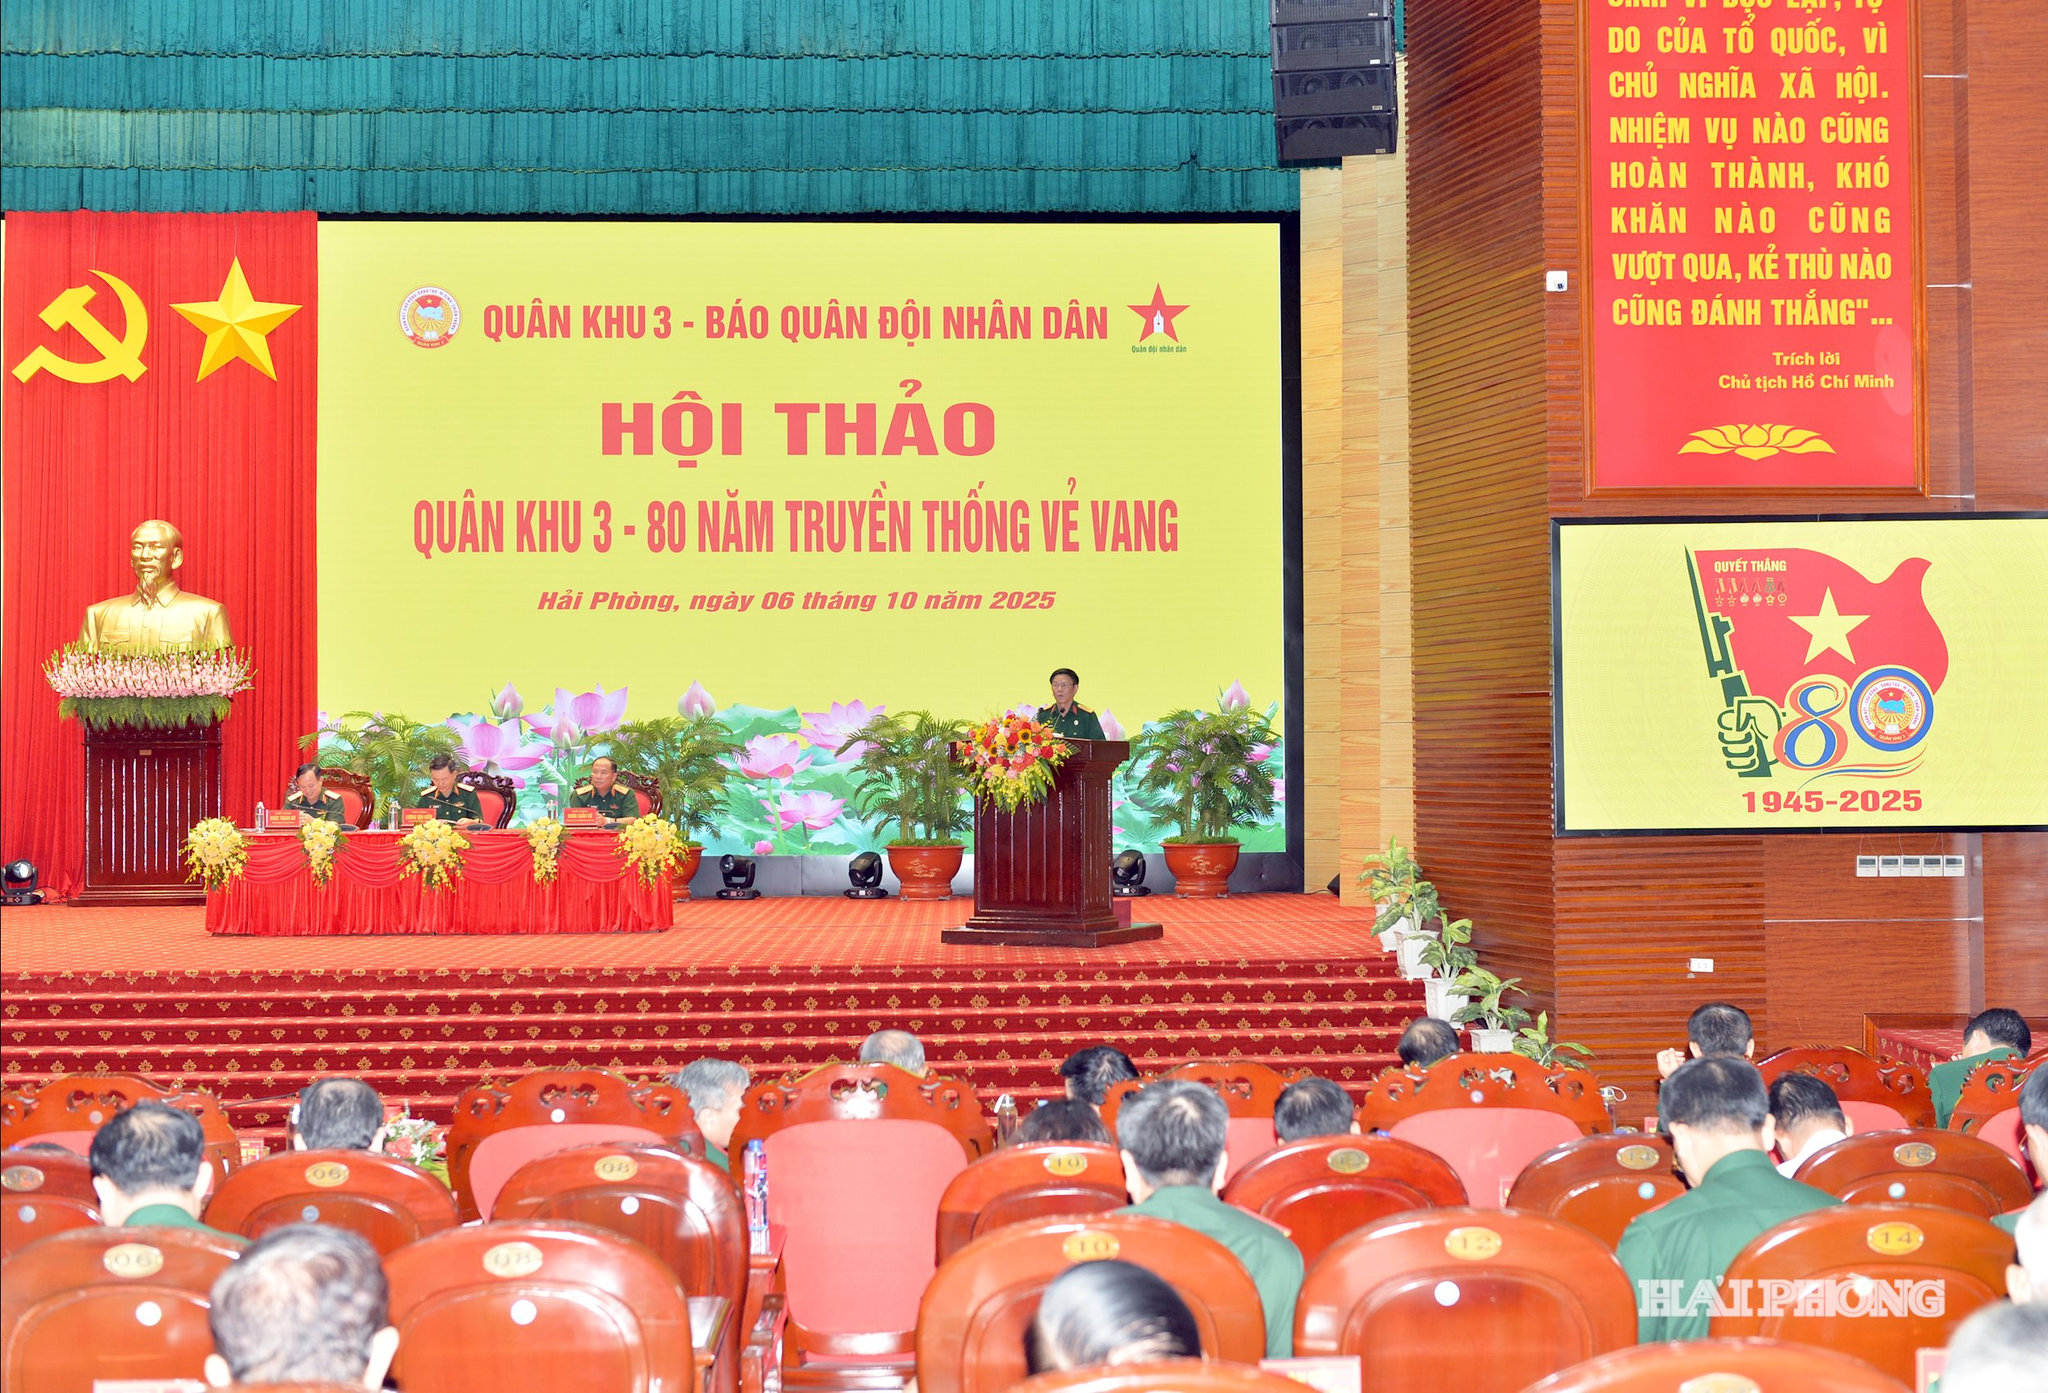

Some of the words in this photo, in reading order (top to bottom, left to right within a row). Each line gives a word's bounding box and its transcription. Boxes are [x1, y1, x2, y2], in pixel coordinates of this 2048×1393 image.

[1609, 26, 1640, 53] DO
[1658, 16, 1706, 53] CỦA
[1723, 13, 1755, 53] TỔ
[1771, 18, 1845, 56] QUỐC,
[1863, 22, 1887, 53] VÌ
[1609, 61, 1657, 98] CHỦ
[1680, 66, 1756, 98] NGHĨA
[1780, 67, 1815, 98] XÃ
[1837, 65, 1888, 104] HỘI.
[1610, 112, 1689, 149] NHIỆM
[1705, 118, 1737, 149] VỤ
[1753, 112, 1805, 143] NÀO
[1821, 112, 1888, 143] CŨNG
[1611, 156, 1686, 188] HOÀN
[1711, 156, 1814, 192] THÀNH,
[1837, 156, 1889, 188] KHÓ
[1612, 202, 1686, 233] KHĂN
[1715, 202, 1775, 233] NÀO
[1809, 202, 1890, 233] CŨNG
[1612, 251, 1676, 285] VƯỢT
[1683, 253, 1741, 283] QUA,
[1749, 244, 1779, 279] KẺ
[1785, 247, 1832, 279] THÙ
[1841, 247, 1891, 279] NÀO
[1613, 294, 1681, 325] CŨNG
[1691, 294, 1761, 325] ĐÁNH
[484, 298, 570, 342] QUÂN
[583, 306, 645, 339] KHU
[654, 306, 671, 338] 3
[706, 299, 768, 339] BÁO
[781, 299, 867, 343] QUÂN
[878, 299, 930, 347] ĐỘI
[944, 299, 1031, 339] NHÂN
[1044, 299, 1107, 339] DÂN
[1773, 352, 1814, 365] Trích
[1820, 352, 1840, 365] lời
[1719, 374, 1750, 388] Chủ
[1755, 376, 1787, 392] tịch
[1792, 373, 1814, 388] Hồ
[1821, 375, 1849, 388] Chí
[1855, 374, 1894, 387] Minh
[602, 391, 742, 468] HỘI
[775, 379, 994, 456] THẢO
[414, 489, 504, 559] QUÂN
[517, 501, 581, 553] KHU
[594, 501, 611, 553] 3
[624, 526, 635, 535] -
[648, 501, 685, 553] 80
[698, 489, 773, 552] NĂM
[785, 481, 910, 552] TRUYỀN
[922, 481, 1029, 552] THỐNG
[1041, 477, 1079, 552] VẺ
[1091, 500, 1178, 552] VANG
[1715, 558, 1748, 573] QUYẾT
[538, 590, 582, 610] Hải
[590, 592, 679, 612] Phòng,
[689, 591, 755, 612] ngày
[761, 592, 794, 609] 06
[802, 591, 877, 612] tháng
[888, 592, 918, 609] 10
[924, 591, 982, 609] năm
[989, 592, 1056, 609] 2025
[1742, 790, 1922, 812] 1945-2025
[313, 1168, 341, 1180] 06
[1056, 1157, 1080, 1169] 10
[1080, 1240, 1109, 1253] 10
[1462, 1236, 1492, 1251] 12
[1880, 1231, 1913, 1245] 14
[114, 1252, 152, 1267] 06
